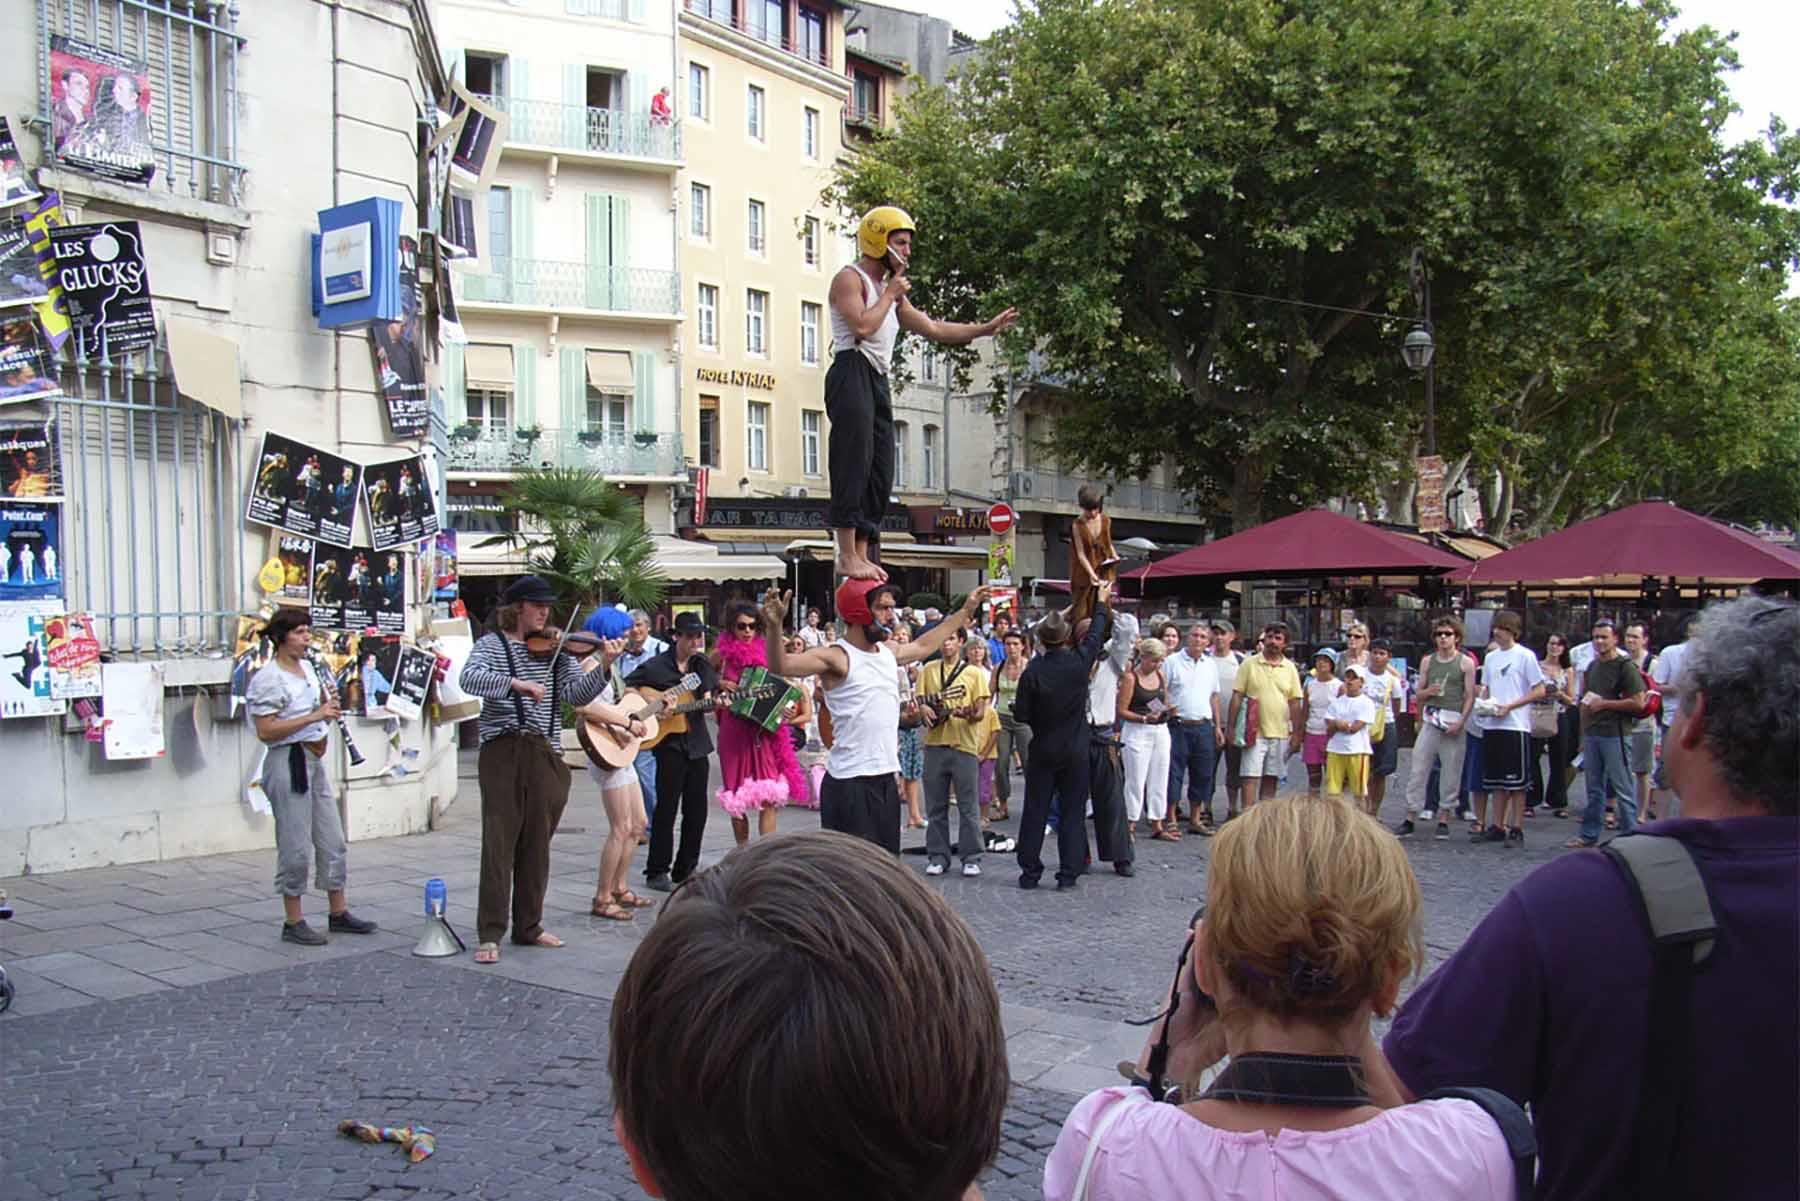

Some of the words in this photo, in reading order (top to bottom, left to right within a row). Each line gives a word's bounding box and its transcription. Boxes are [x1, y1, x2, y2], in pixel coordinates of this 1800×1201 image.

[53, 241, 85, 259] LES
[61, 261, 139, 292] GLUCKS
[731, 370, 776, 391] KYRIAD
[751, 511, 821, 525] TABAC
[936, 514, 967, 528] HOTEL
